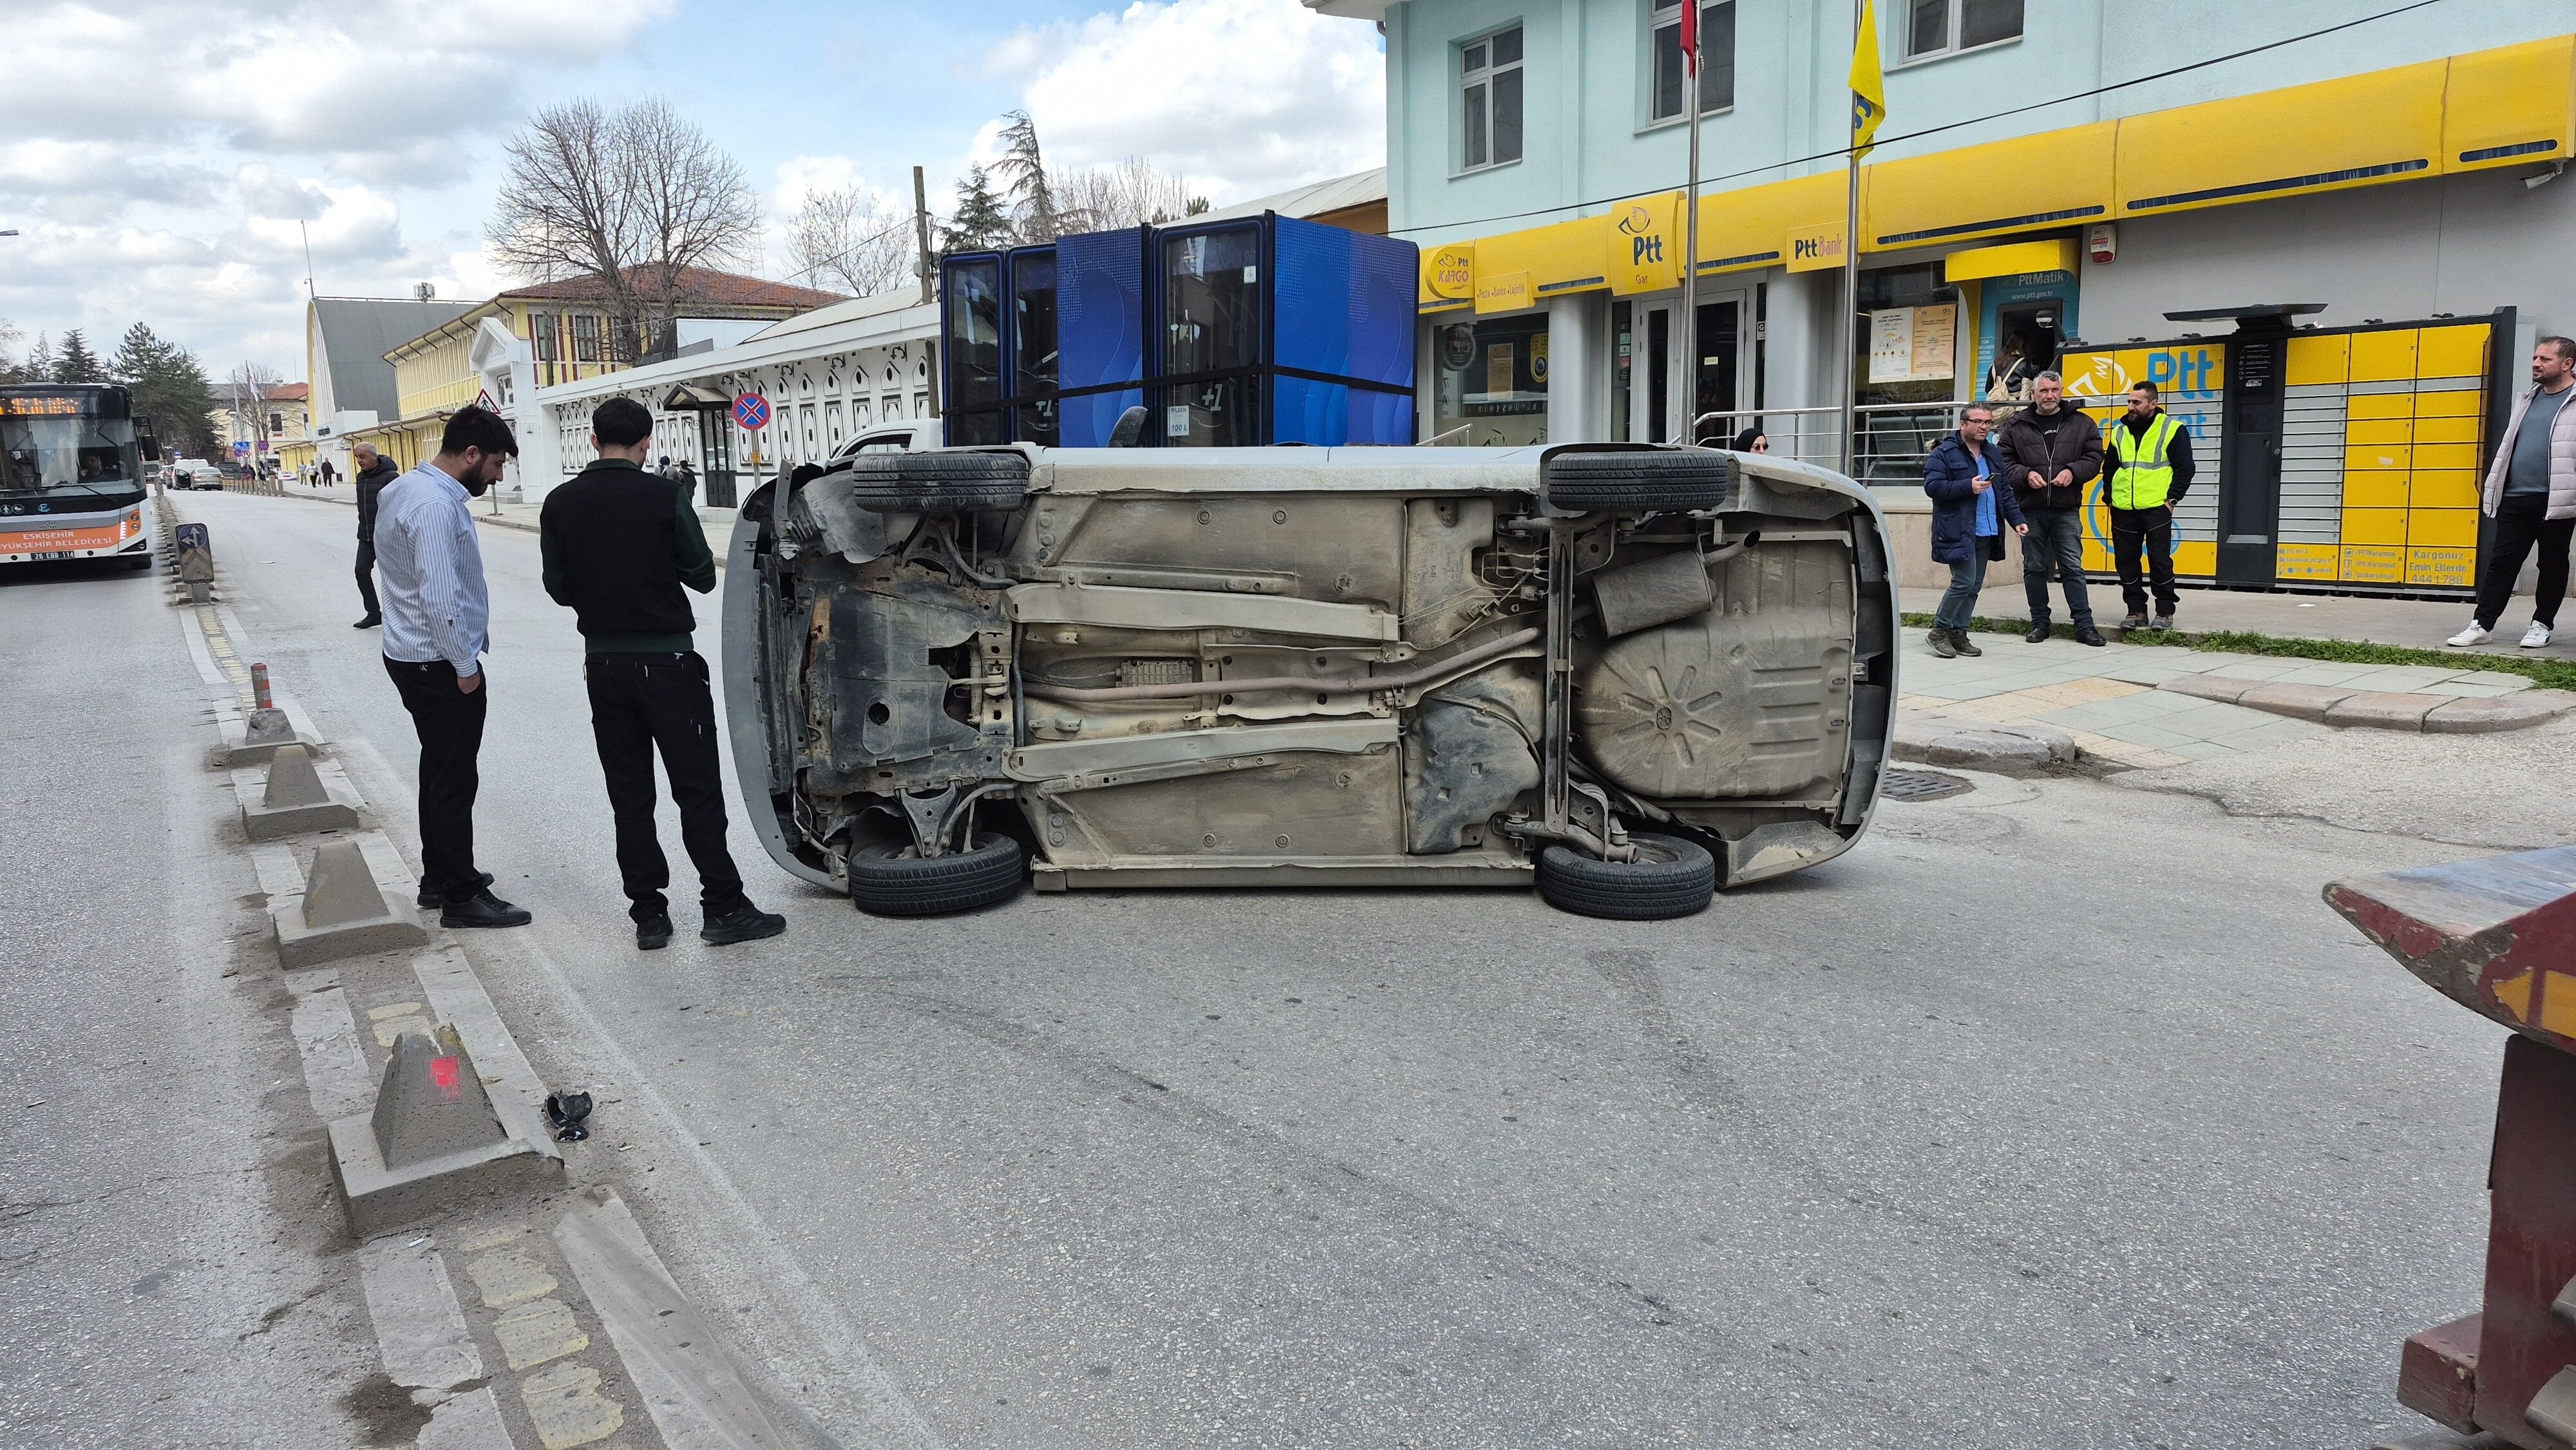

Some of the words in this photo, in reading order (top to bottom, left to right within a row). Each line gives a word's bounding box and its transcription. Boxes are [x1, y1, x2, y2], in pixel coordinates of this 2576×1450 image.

[1634, 234, 1663, 266] Ptt
[1458, 258, 1469, 267] Ptt
[1438, 270, 1469, 283] KARGO
[1636, 274, 1648, 284] Gar
[2018, 270, 2064, 287] PttMatik
[2011, 290, 2054, 300] www.ptt.gov.tr
[2148, 350, 2214, 400] Ptt
[23, 531, 75, 540] ESKİŞEHİR
[0, 540, 52, 550] YÜKŞEHİR
[55, 536, 111, 546] BELEDİYESİ
[2414, 550, 2464, 560] Kargonuz
[2410, 562, 2431, 572] Emin
